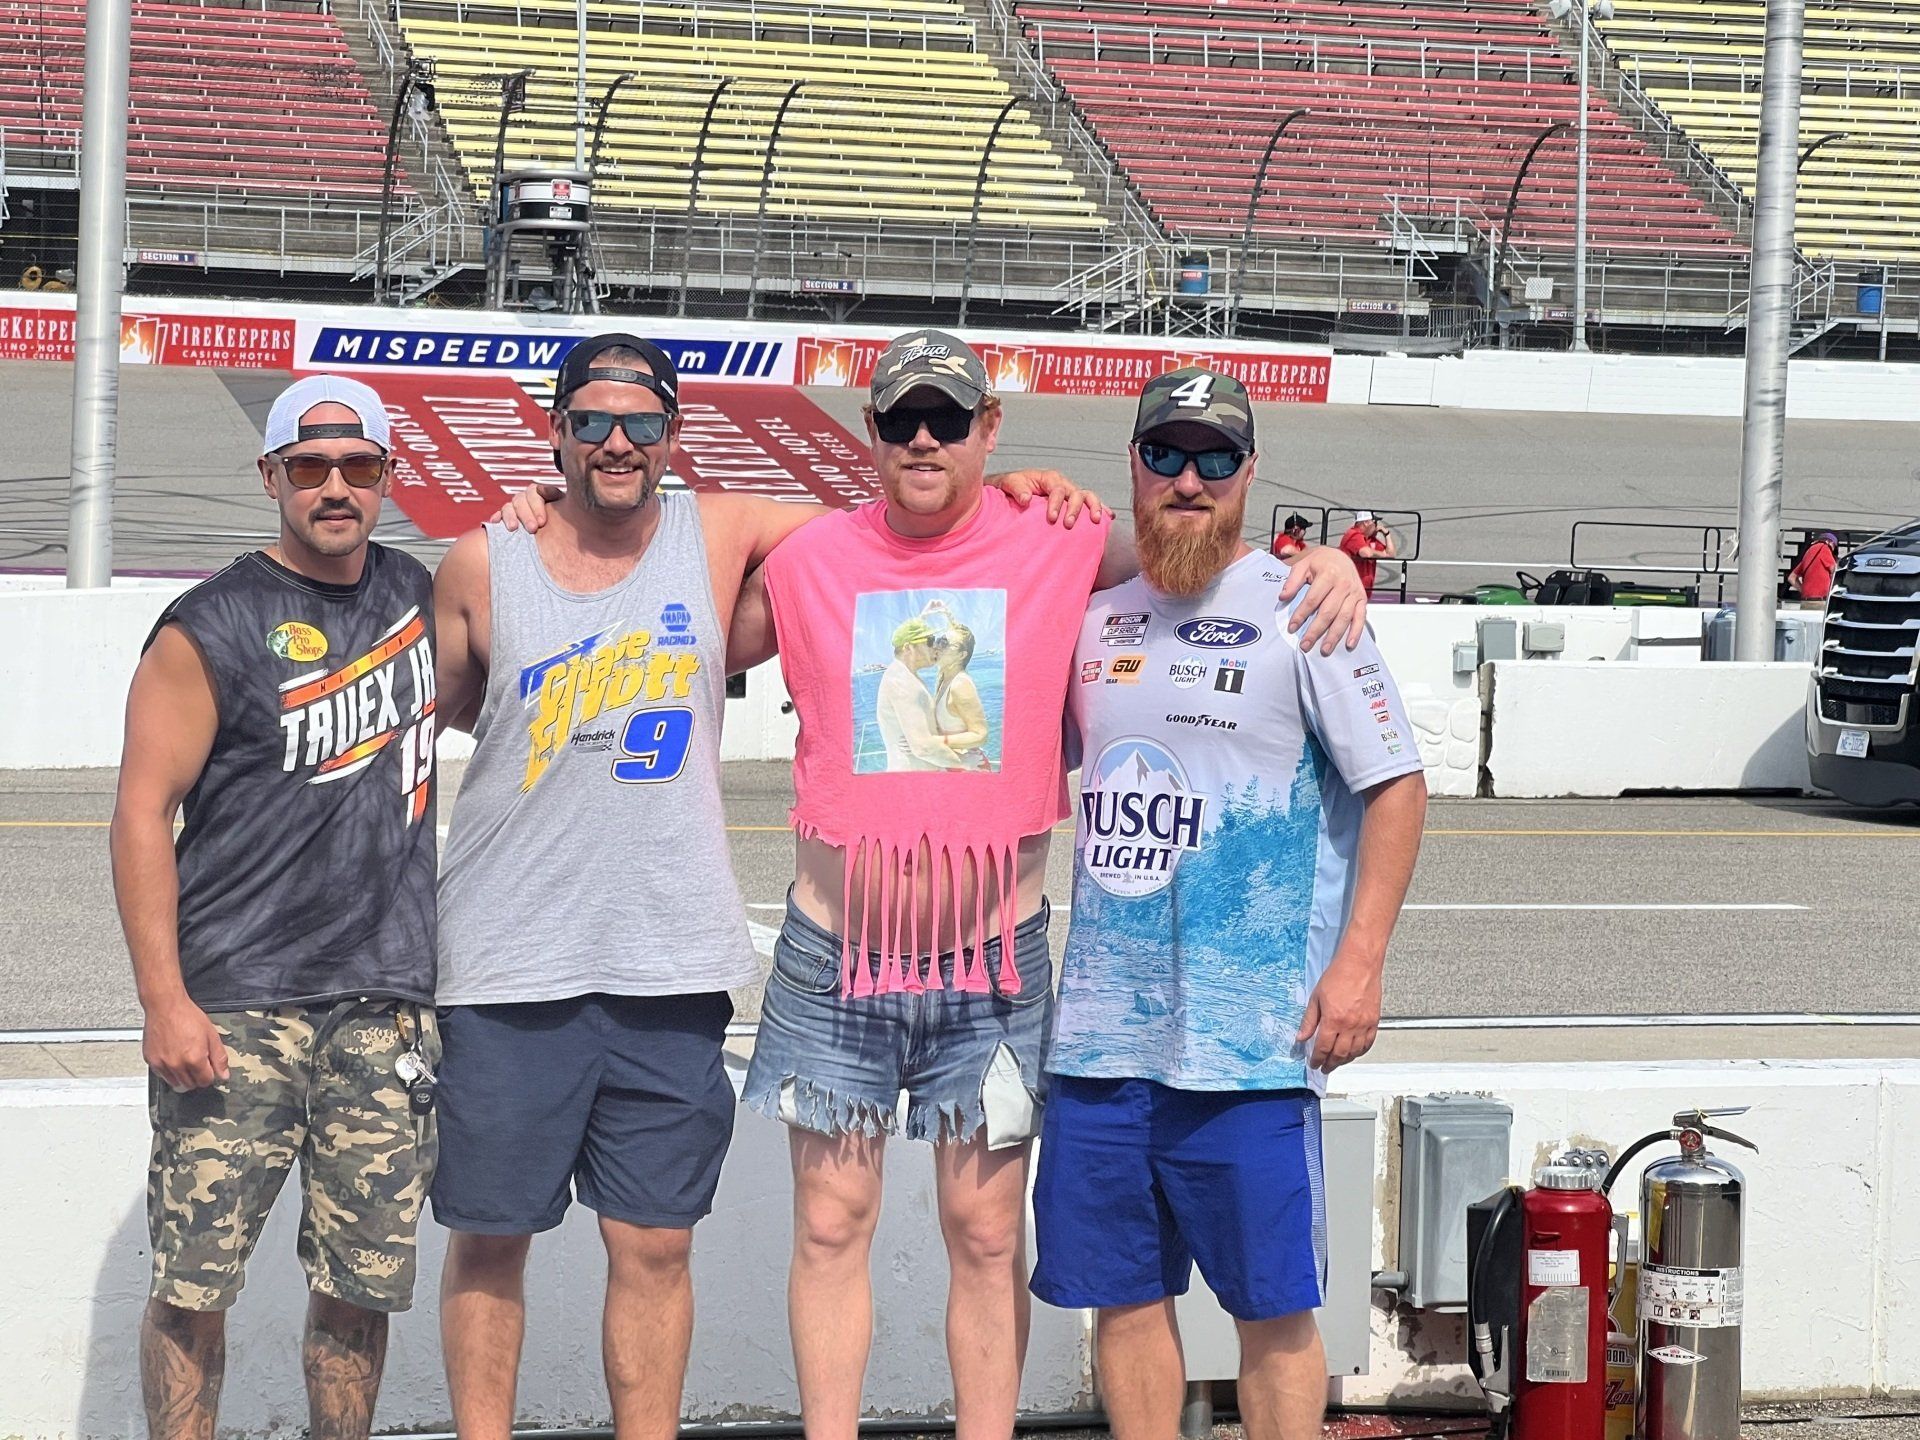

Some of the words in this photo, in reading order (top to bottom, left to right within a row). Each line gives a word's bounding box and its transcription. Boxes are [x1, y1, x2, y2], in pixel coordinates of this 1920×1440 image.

[142, 252, 179, 261] SECTION
[184, 254, 189, 262] 1
[805, 280, 839, 289] SECTION
[842, 282, 848, 290] 2
[1352, 301, 1383, 310] SECTION
[1386, 303, 1392, 311] 4
[182, 350, 229, 359] CASINO
[239, 352, 277, 361] HOTEL
[1054, 379, 1096, 388] CASINO
[1105, 381, 1139, 389] HOTEL
[1170, 373, 1213, 409] 4
[1280, 387, 1313, 396] HOTEL
[755, 417, 821, 462] HOTEL
[422, 462, 484, 503] HOTEL
[664, 610, 689, 625] NAPA
[289, 624, 311, 636] Bass
[1189, 620, 1245, 645] Ford
[294, 635, 310, 645] Pro
[657, 635, 689, 647] RACING
[296, 644, 324, 656] Shops
[1113, 660, 1142, 673] GW
[1220, 658, 1248, 669] Mobil
[1169, 664, 1207, 678] BUSCH
[1362, 682, 1385, 697] BUSCH
[280, 661, 400, 772] TRUEX
[571, 730, 616, 746] Hendrick
[611, 706, 696, 785] 9
[400, 712, 436, 796] 19
[1091, 845, 1171, 871] LIGHT
[1656, 1267, 1699, 1277] INSTRUCTIONS
